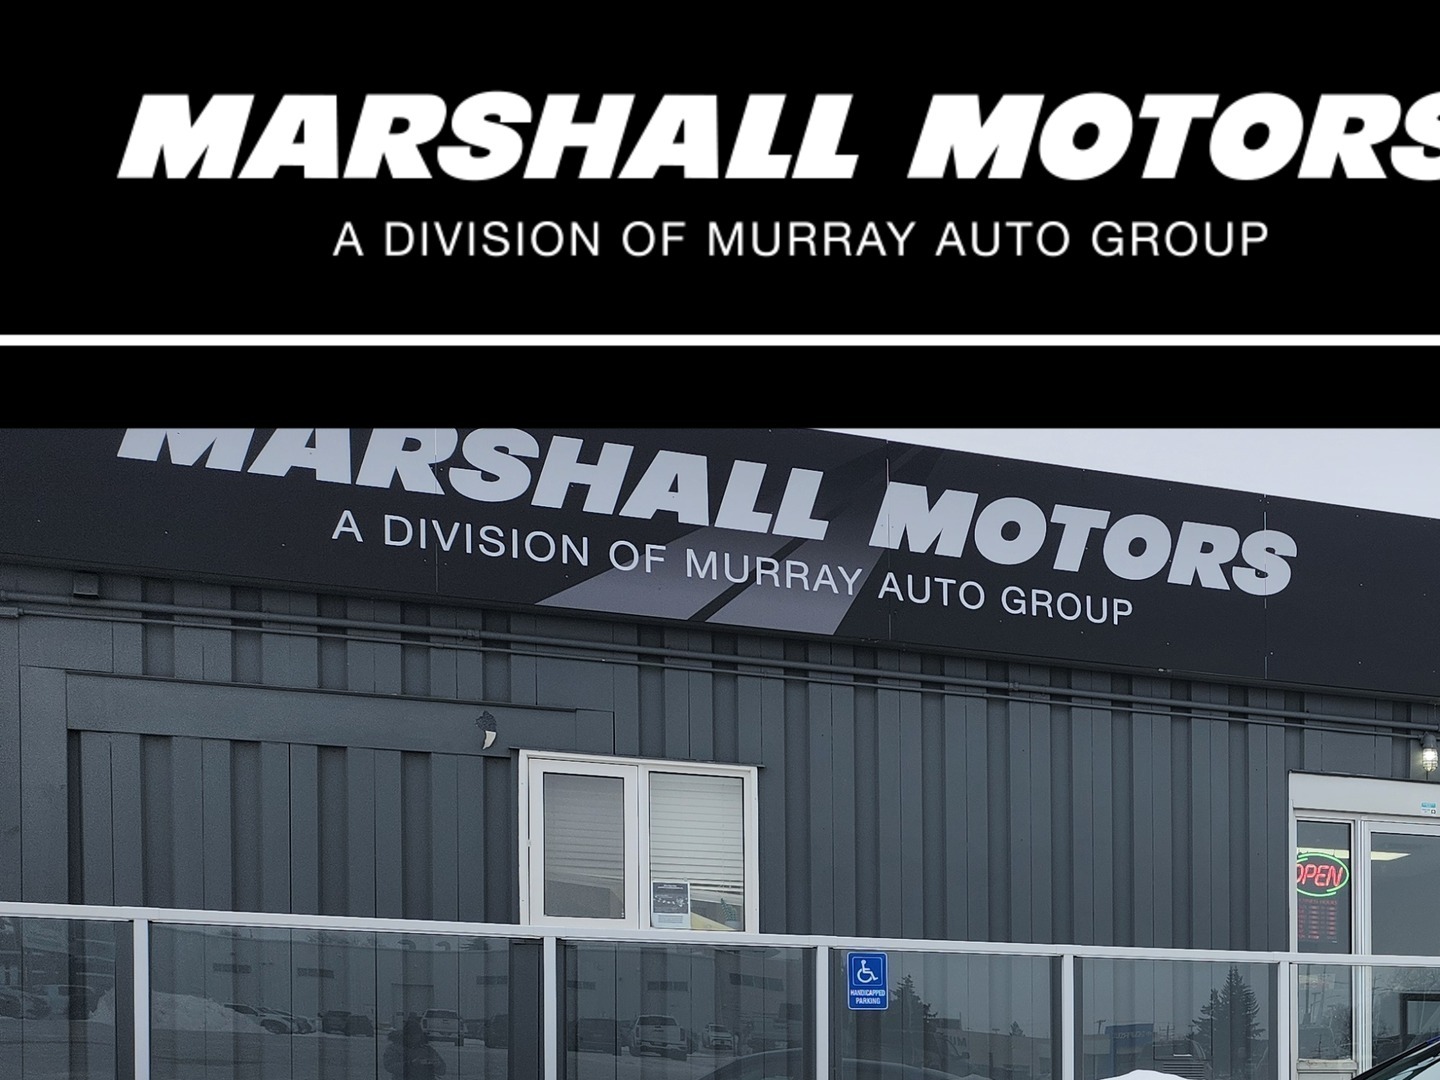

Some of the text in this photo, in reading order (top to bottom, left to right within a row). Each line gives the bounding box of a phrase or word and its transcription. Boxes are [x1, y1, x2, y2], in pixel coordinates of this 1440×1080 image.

[869, 482, 1297, 596] MOTORS
[332, 511, 1133, 626] A DIVISION OF MURRAY AUTO GROUP
[1297, 863, 1343, 887] OPEN
[850, 989, 886, 997] HANDICAPPED
[855, 997, 881, 1005] PARKING
